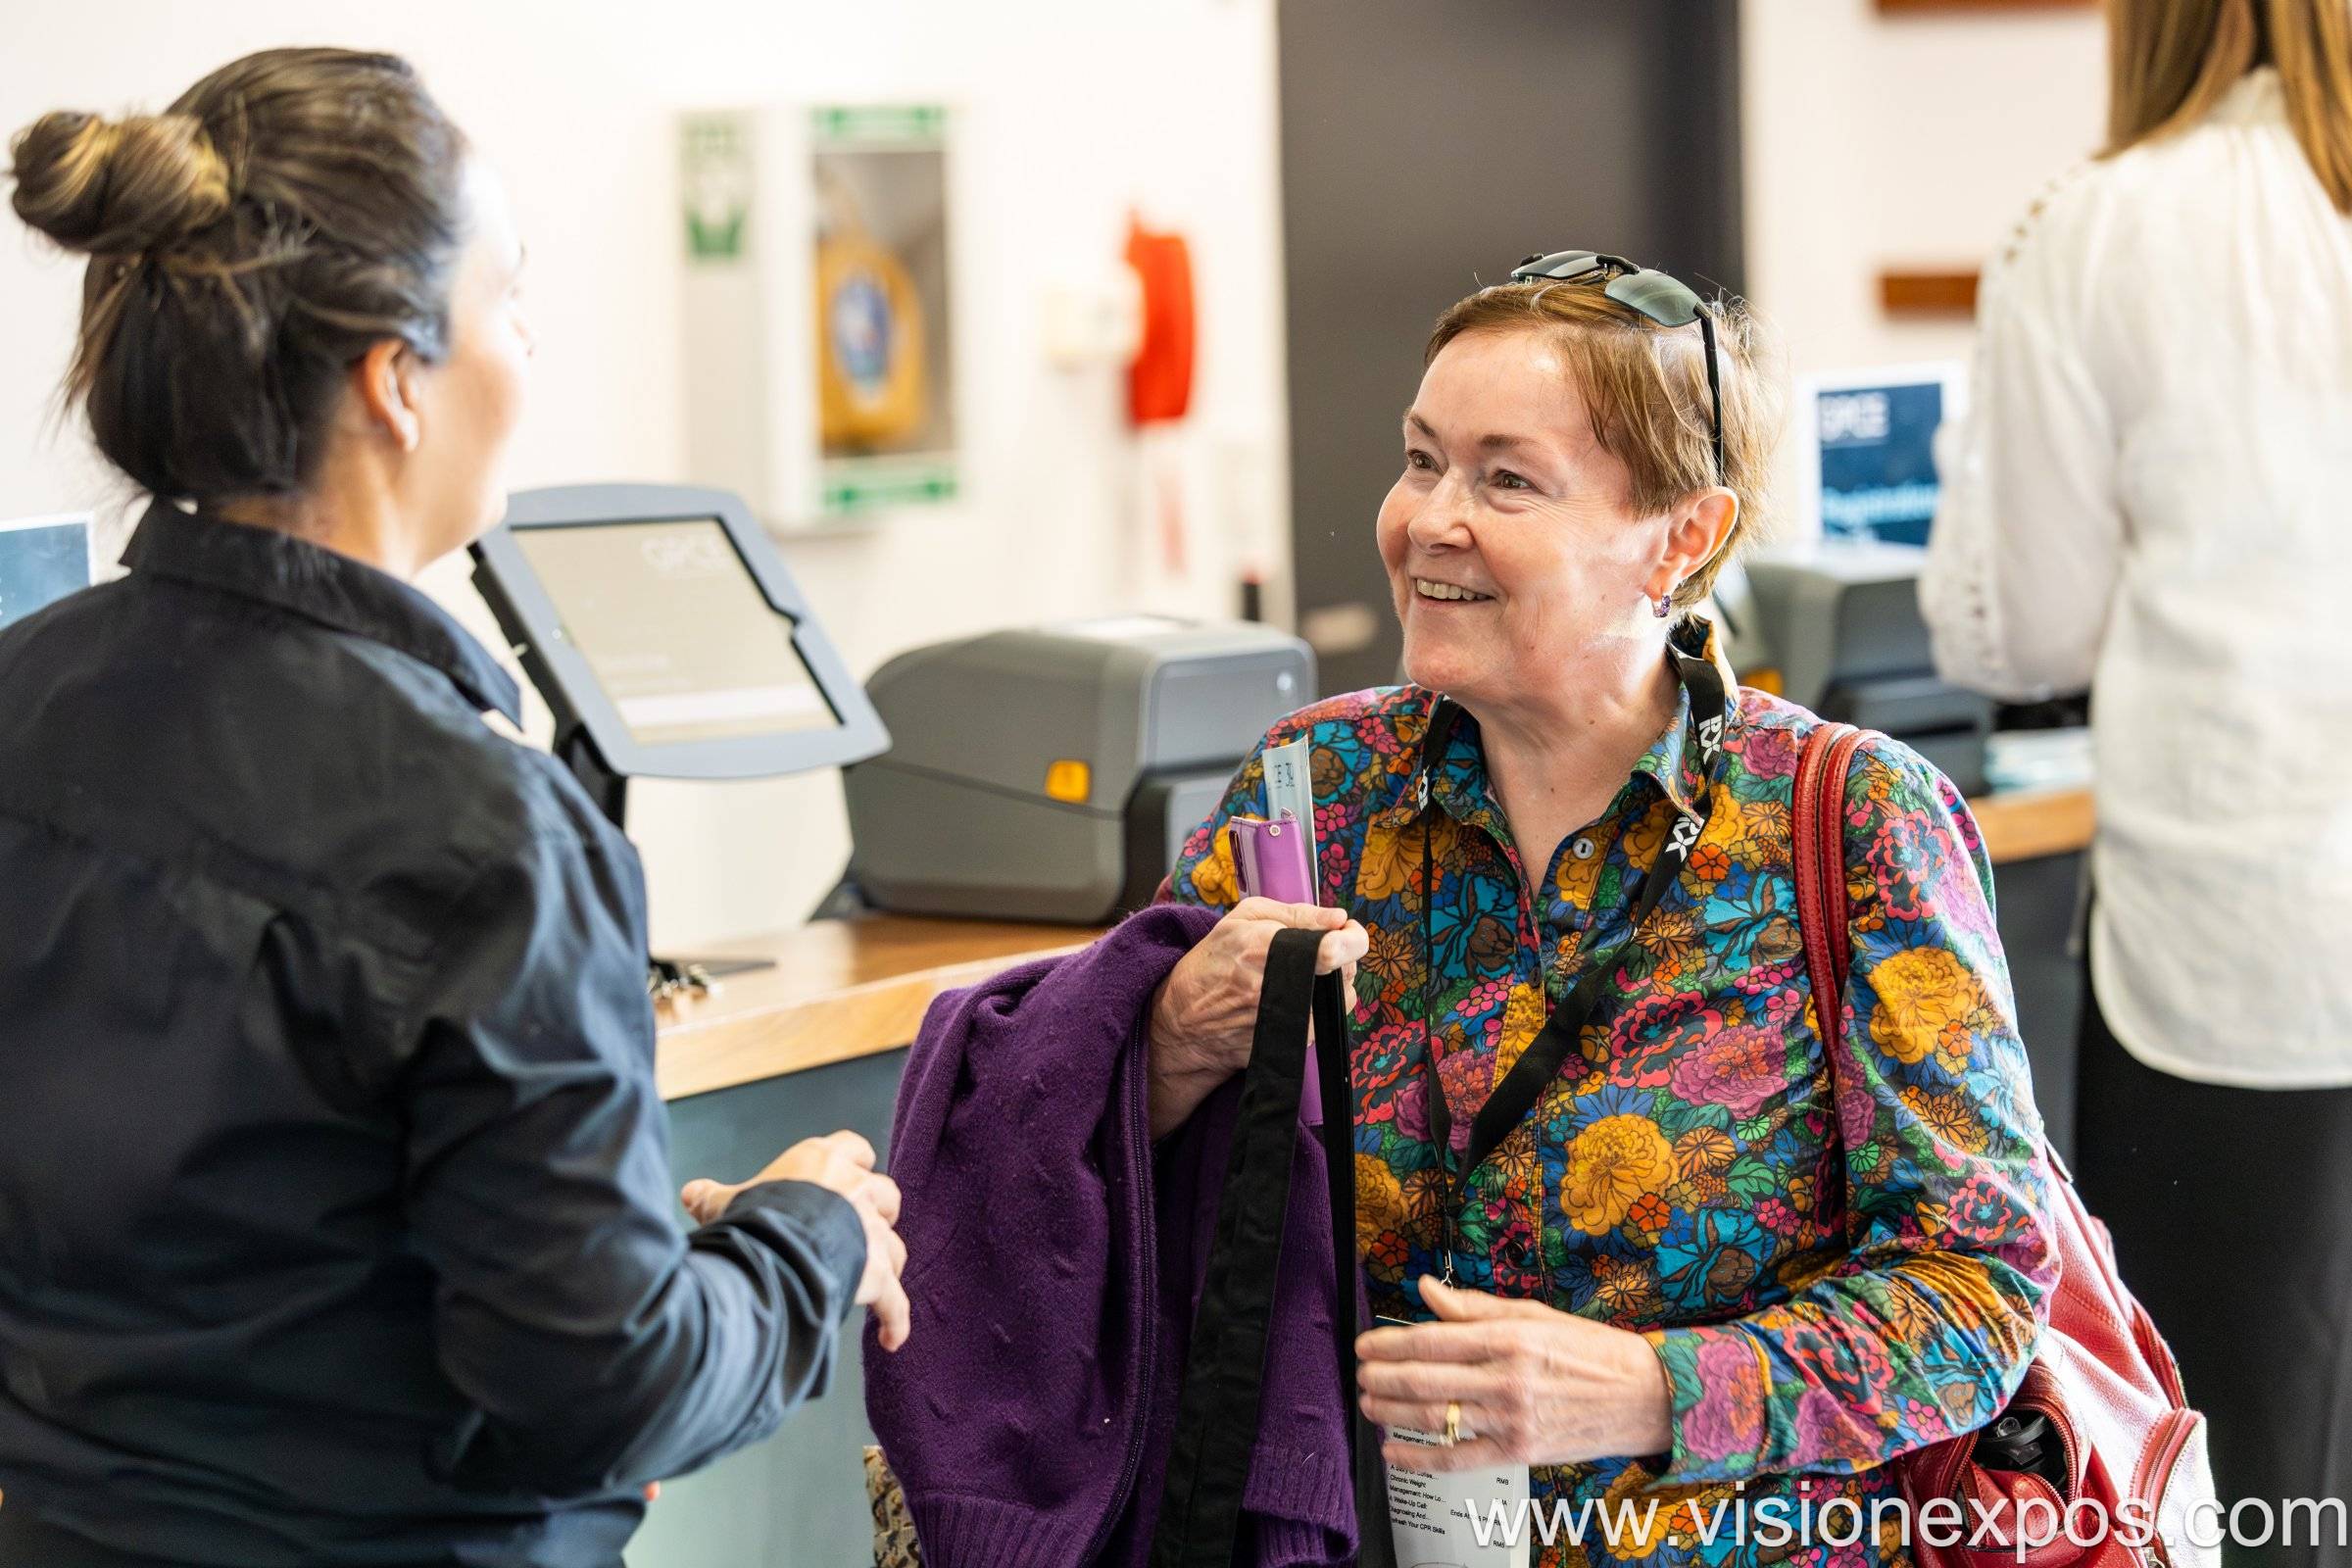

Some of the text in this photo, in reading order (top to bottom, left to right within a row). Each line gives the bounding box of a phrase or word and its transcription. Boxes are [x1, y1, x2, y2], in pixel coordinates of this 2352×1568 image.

[1409, 1478, 1427, 1488] Weight
[1422, 1492, 1434, 1500] How
[1407, 1520, 1419, 1529] Your
[1419, 1523, 1432, 1532] CPR
